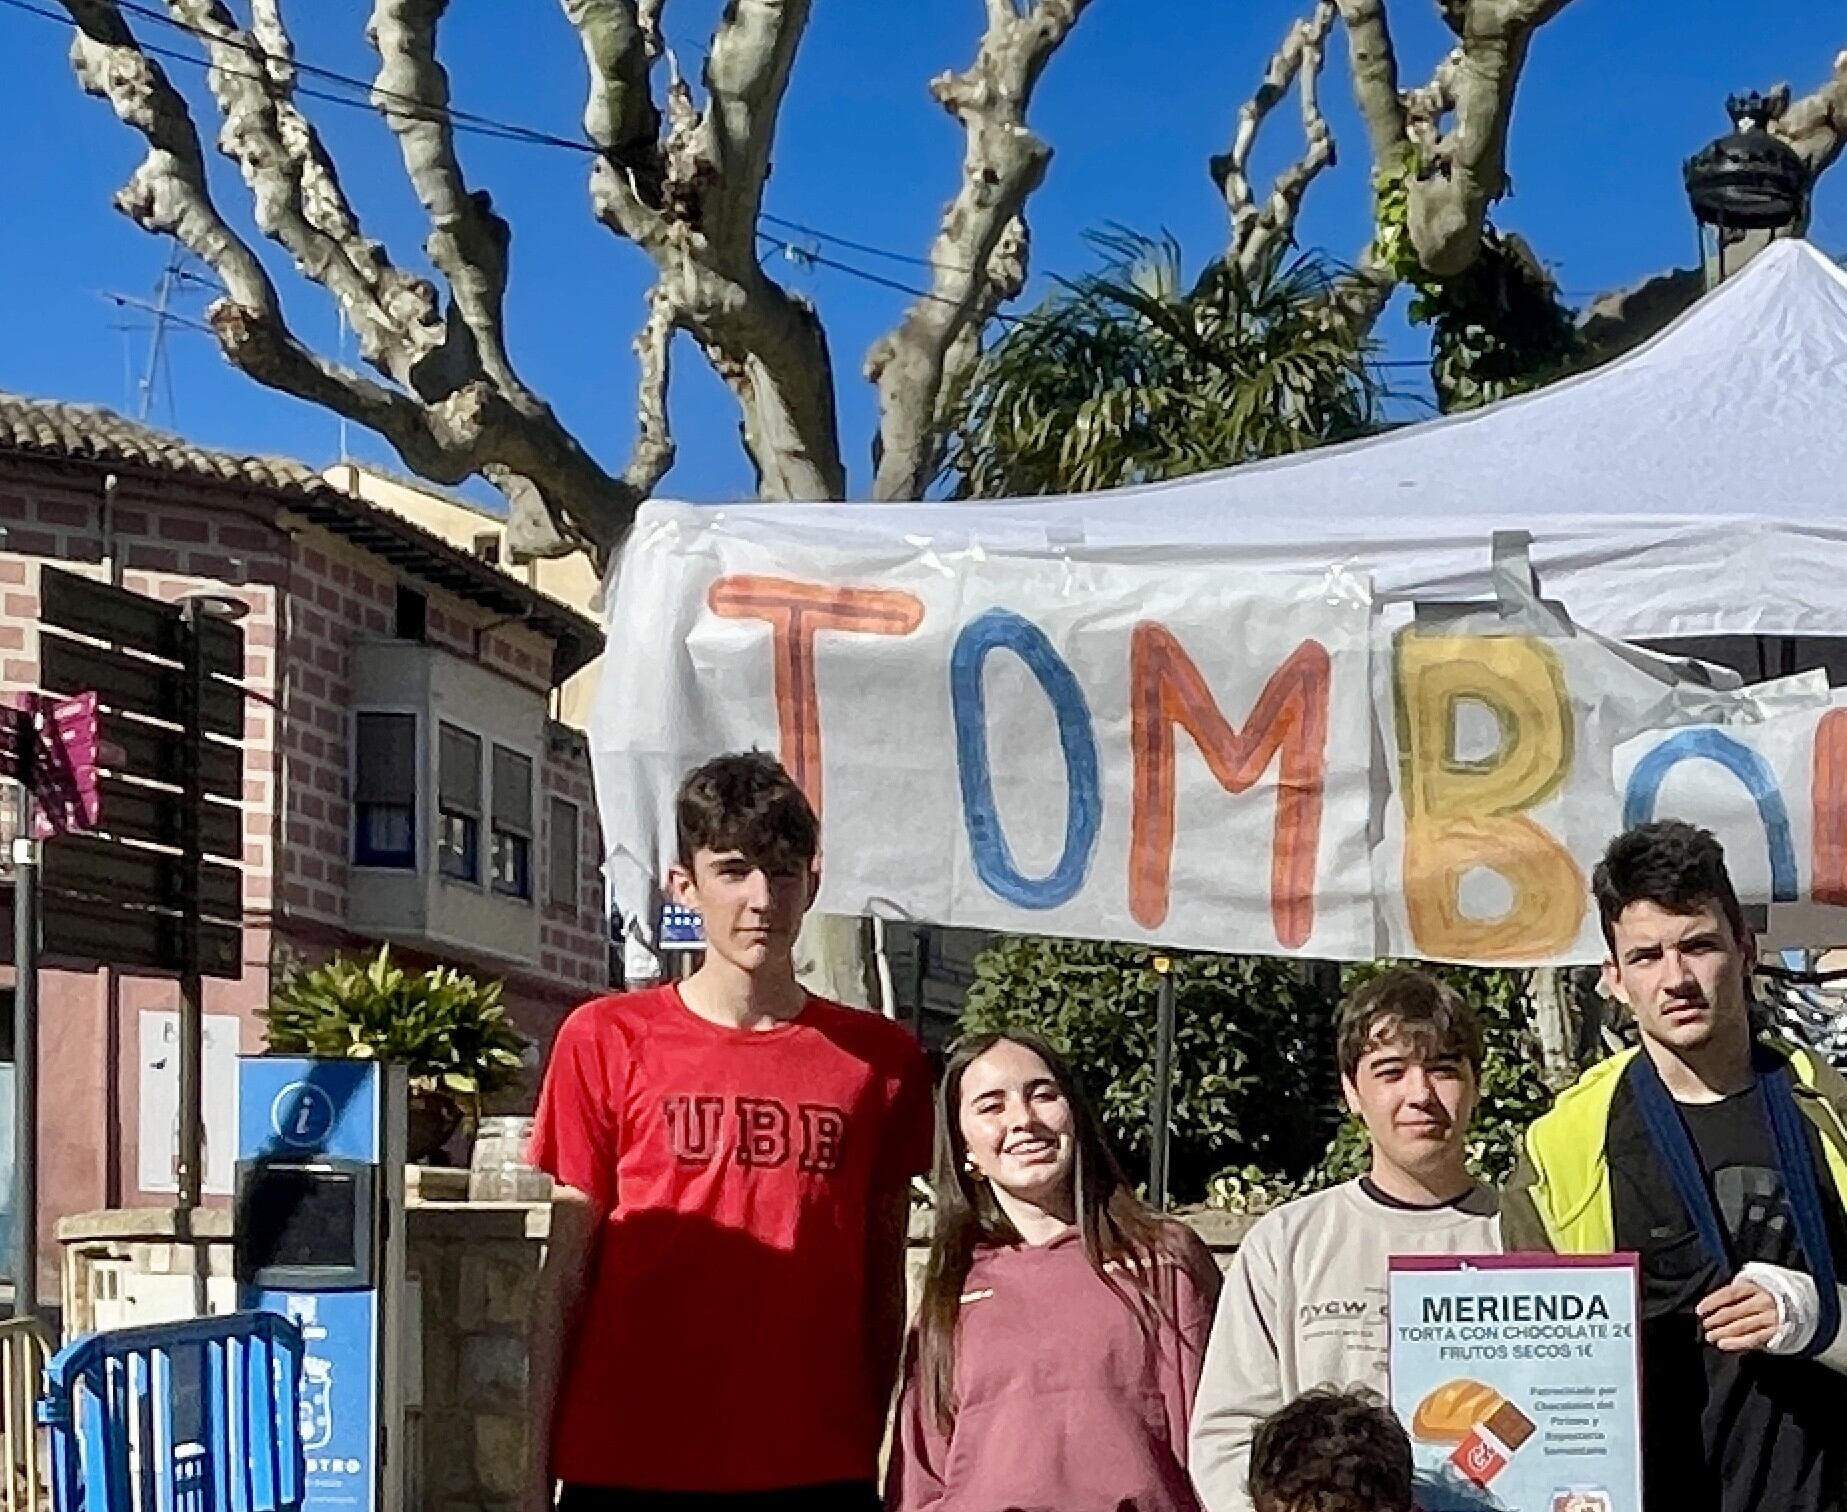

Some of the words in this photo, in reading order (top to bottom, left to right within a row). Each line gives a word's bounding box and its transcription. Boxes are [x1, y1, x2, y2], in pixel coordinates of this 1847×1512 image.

[1422, 1294, 1610, 1323] MERIENDA
[1398, 1326, 1457, 1342] TORTA
[1459, 1325, 1499, 1341] CON
[1502, 1324, 1608, 1341] CHOCOLATE
[1440, 1344, 1508, 1361] FRUTOS
[1512, 1343, 1570, 1360] SECOS
